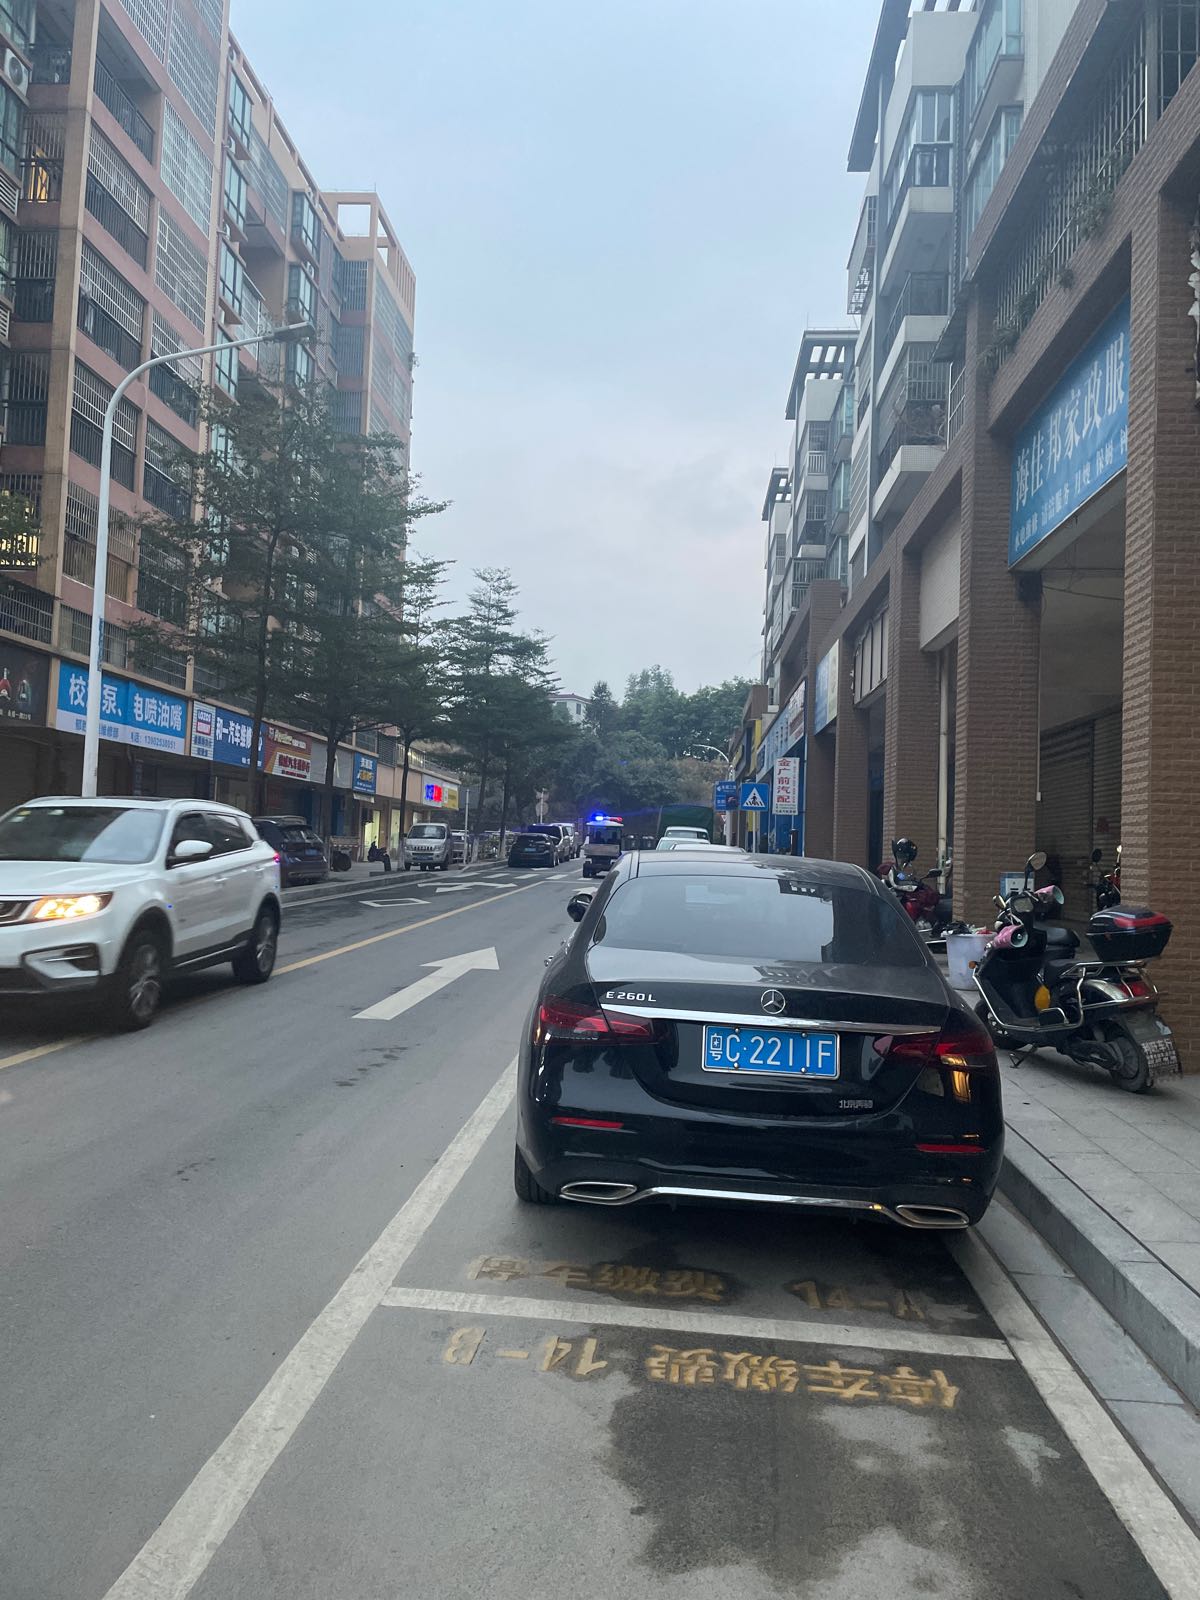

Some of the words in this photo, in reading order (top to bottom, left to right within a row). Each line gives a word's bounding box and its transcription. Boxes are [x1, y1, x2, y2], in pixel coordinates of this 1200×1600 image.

[69, 673, 122, 717] 校泵、
[133, 692, 182, 731] 电喷油嘴
[777, 758, 792, 803] 金广前汽配
[617, 992, 645, 1001] 260
[644, 1342, 962, 1410] 停车缴费
